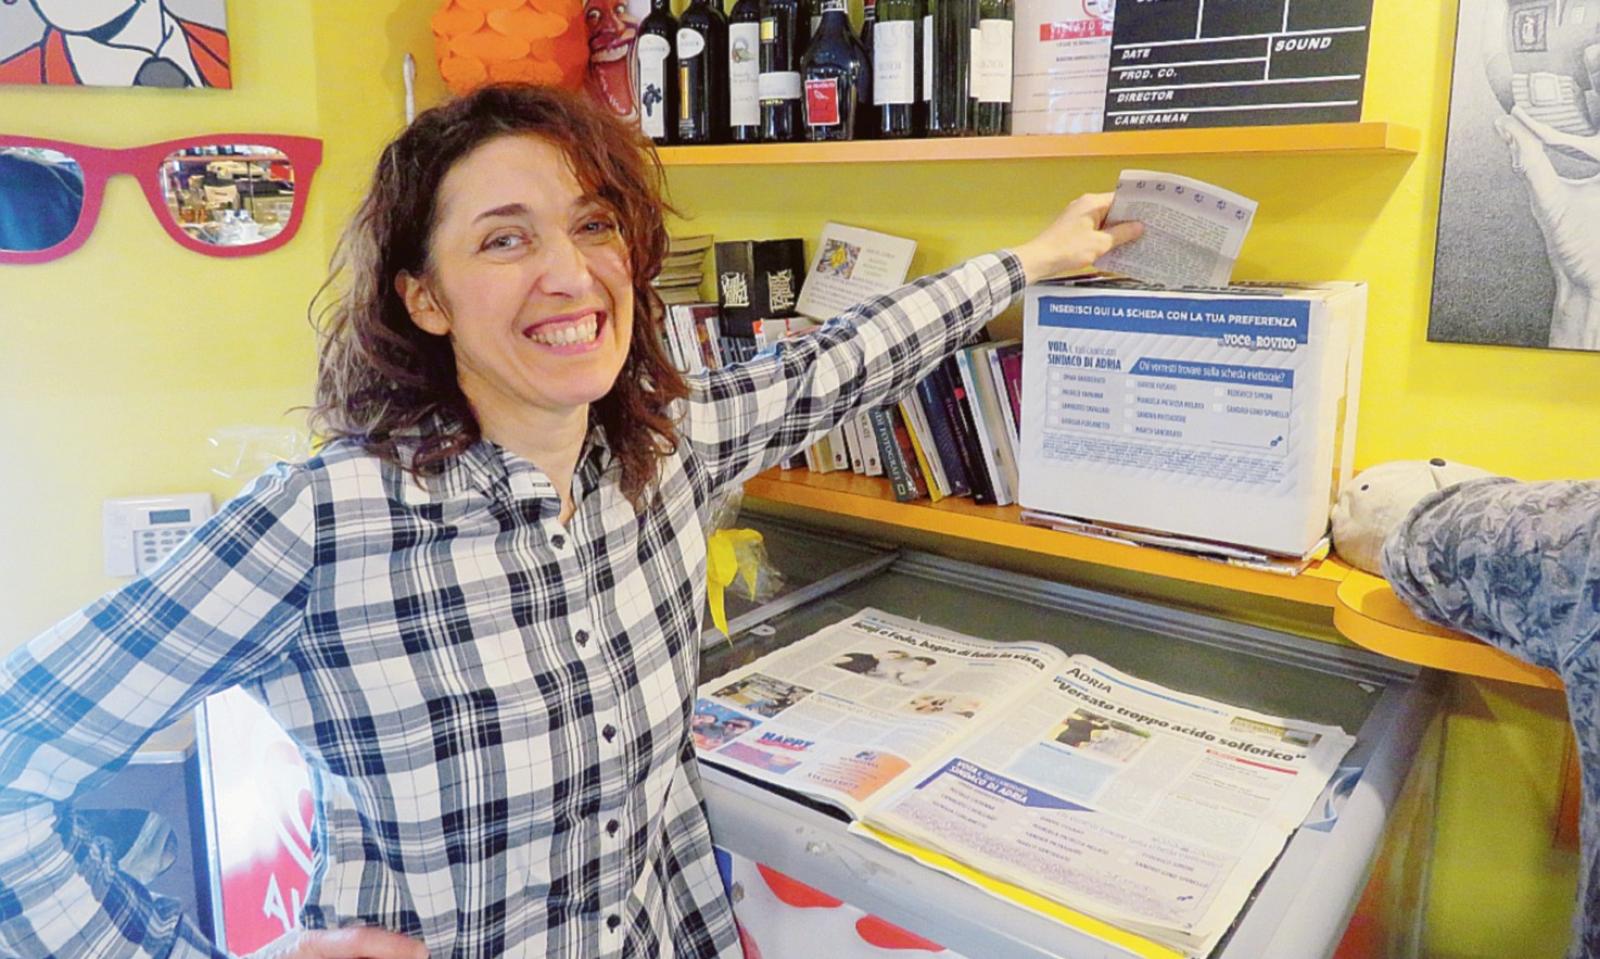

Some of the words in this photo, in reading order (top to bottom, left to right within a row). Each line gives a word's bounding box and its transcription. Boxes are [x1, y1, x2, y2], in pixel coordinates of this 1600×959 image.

[1274, 37, 1332, 52] SOUND
[1121, 48, 1151, 60] DATE
[1119, 69, 1153, 80] PROD.
[1157, 68, 1178, 79] CO.
[1116, 90, 1174, 103] DIRECTOR
[1114, 113, 1189, 126] CAMERAMAN
[1049, 303, 1092, 314] INSERISCI
[1093, 305, 1111, 316] QUI
[1112, 307, 1124, 317] LA
[1126, 308, 1164, 319] SCHEDA
[1166, 311, 1188, 321] CON
[1190, 312, 1203, 321] LA
[1205, 313, 1226, 323] TUA
[1228, 315, 1297, 328] PREFERENZA
[1047, 340, 1068, 353] VOTA
[1256, 336, 1297, 350] ROVIGO
[1047, 353, 1082, 367] SINDACO
[1083, 355, 1093, 368] DI
[1095, 356, 1121, 370] ADRIA
[1013, 653, 1046, 671] vista
[1065, 667, 1112, 693] ADRIA
[1116, 707, 1170, 727] troppo
[1170, 724, 1216, 741] acido
[761, 732, 815, 748] HAPPY
